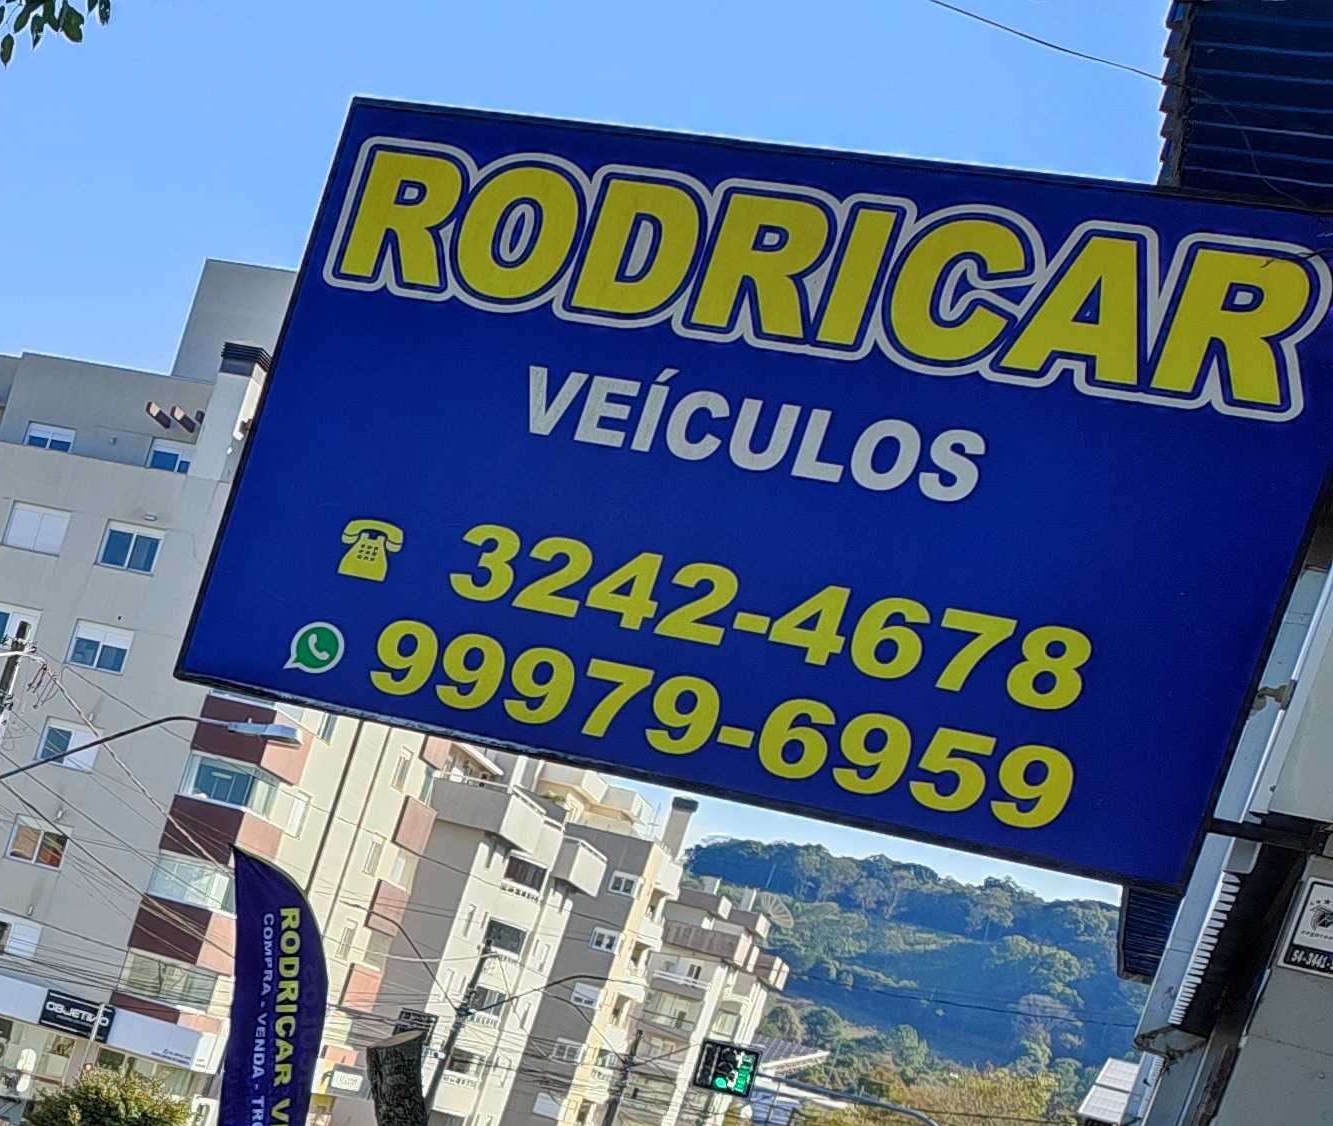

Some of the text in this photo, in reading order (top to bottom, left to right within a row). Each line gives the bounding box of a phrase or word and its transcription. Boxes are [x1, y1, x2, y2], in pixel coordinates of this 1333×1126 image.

[324, 136, 1333, 422] RODRICAR
[529, 367, 986, 501] VEÍCULOS
[450, 525, 1092, 710] 3242-4678
[370, 619, 1074, 829] 99979-6959
[259, 912, 276, 997] COMPRA
[272, 907, 301, 1088] RODRICAR
[251, 1012, 269, 1080] VENDA
